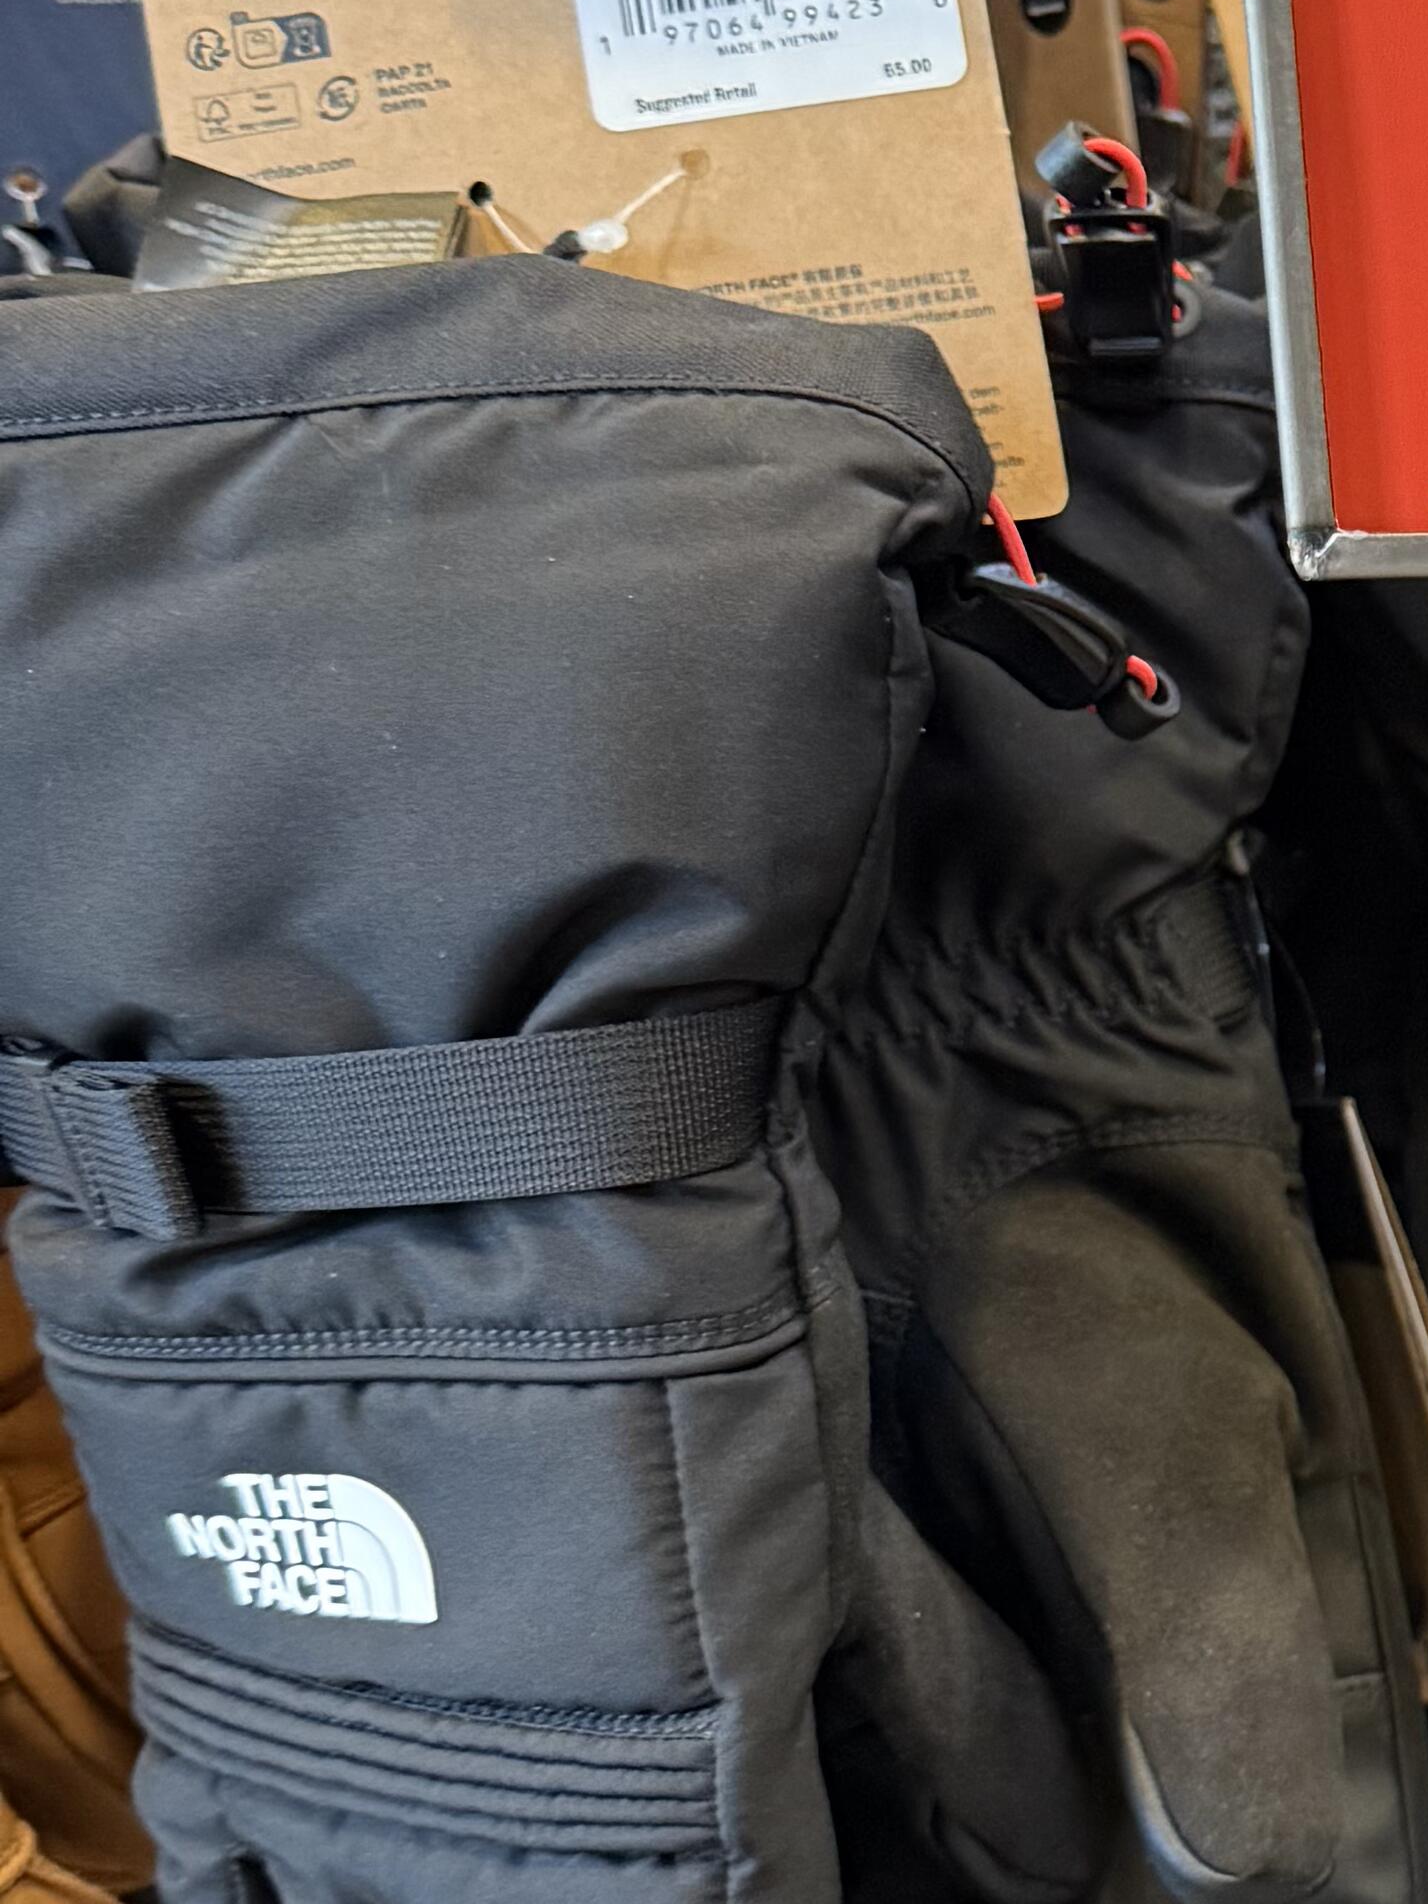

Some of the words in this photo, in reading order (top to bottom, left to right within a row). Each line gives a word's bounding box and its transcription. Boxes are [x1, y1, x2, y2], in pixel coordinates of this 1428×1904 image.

[716, 41, 757, 58] MADE
[634, 88, 712, 115] Suggested
[217, 1472, 335, 1521] THE
[166, 1511, 344, 1568] NORTH
[227, 1560, 351, 1618] FACE
